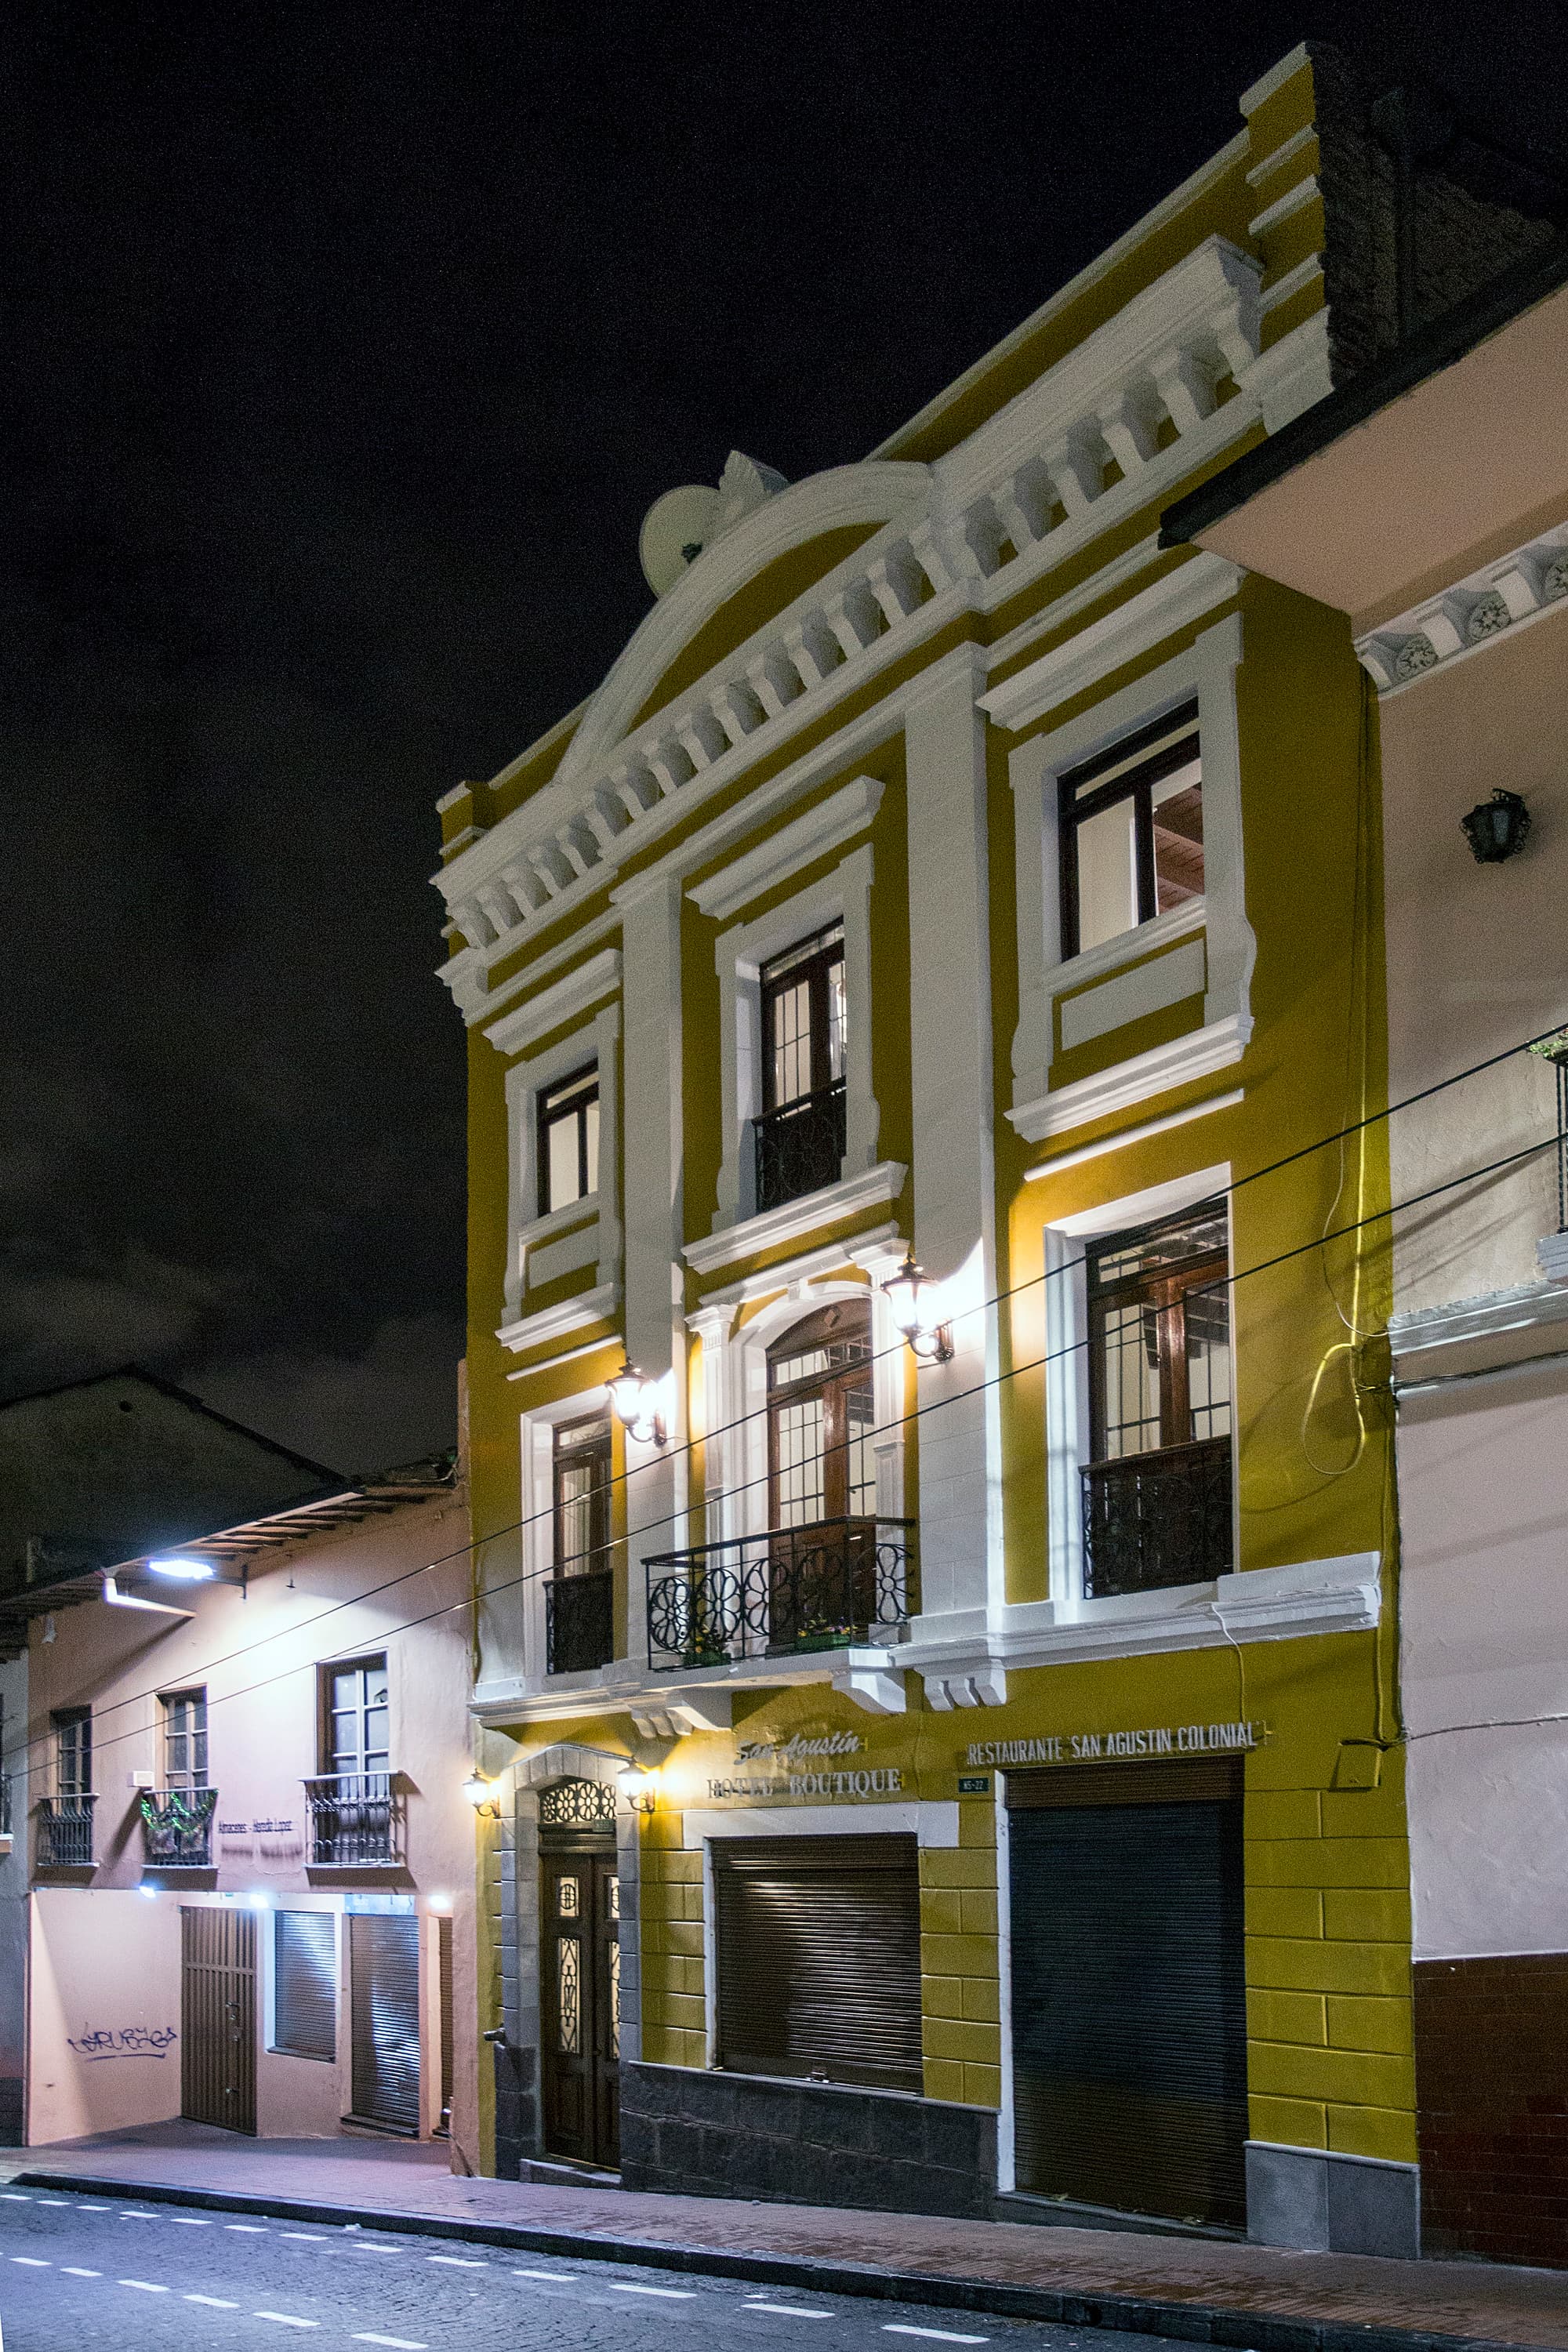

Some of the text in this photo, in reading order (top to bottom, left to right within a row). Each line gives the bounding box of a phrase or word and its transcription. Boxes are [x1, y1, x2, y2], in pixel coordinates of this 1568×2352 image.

[734, 1730, 860, 1765] San Agustín
[967, 1722, 1258, 1766] RESTAURANTE SAN AGUSTIN COLONIAL
[706, 1768, 901, 1798] HOTEL BOUTIQUE
